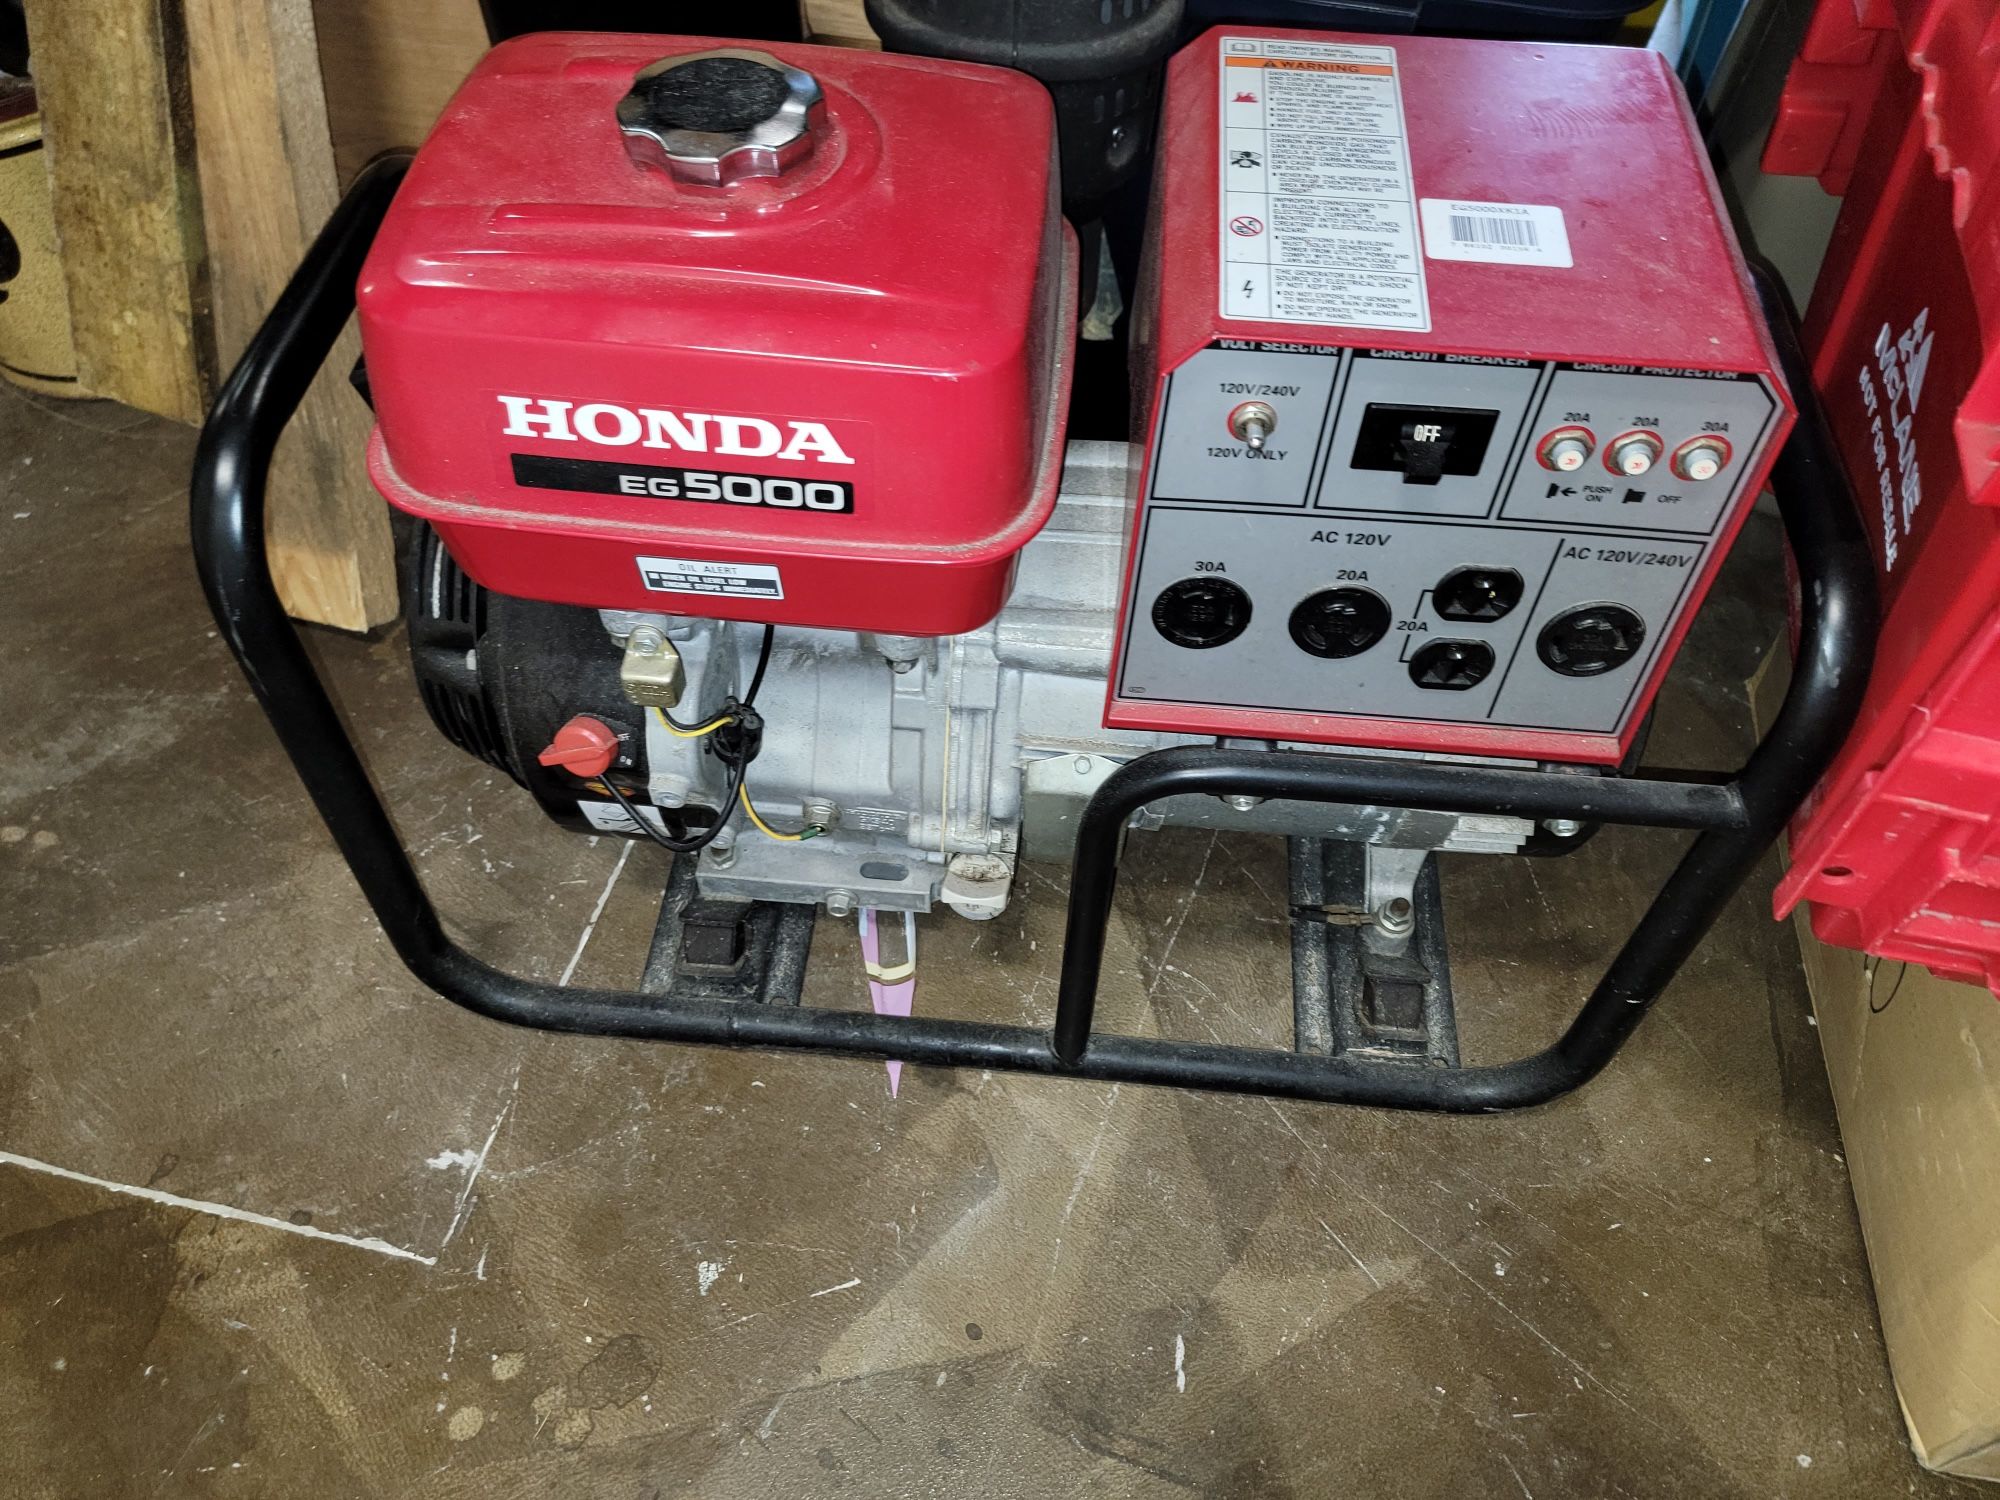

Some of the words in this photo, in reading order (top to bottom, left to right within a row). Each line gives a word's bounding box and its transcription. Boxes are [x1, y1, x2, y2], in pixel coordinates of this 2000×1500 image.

[1282, 60, 1360, 73] WARNING
[1220, 339, 1256, 350] VOLT
[1261, 342, 1338, 354] SELECTOR
[1220, 383, 1301, 396] 120V/240V
[1563, 412, 1590, 423] 20A
[1632, 416, 1660, 427] 20A
[1859, 365, 1878, 417] NOT
[1872, 415, 1887, 472] FOR
[497, 395, 856, 464] HONDA
[1414, 424, 1442, 442] OFF
[1701, 422, 1729, 432] 30A
[1207, 448, 1242, 458] 120V
[1246, 449, 1288, 460] ONLY
[1582, 485, 1613, 494] PUSH
[1585, 494, 1604, 502] ON
[1657, 495, 1682, 504] OFF
[1310, 530, 1340, 544] AC
[1346, 533, 1392, 546] 120V
[1563, 546, 1592, 560] AC
[1597, 549, 1692, 568] 120V/240V
[678, 564, 696, 572] OIL
[704, 566, 738, 574] ALERT
[1194, 560, 1226, 572] 30A
[1336, 570, 1368, 582] 20A
[1396, 620, 1428, 632] 20A
